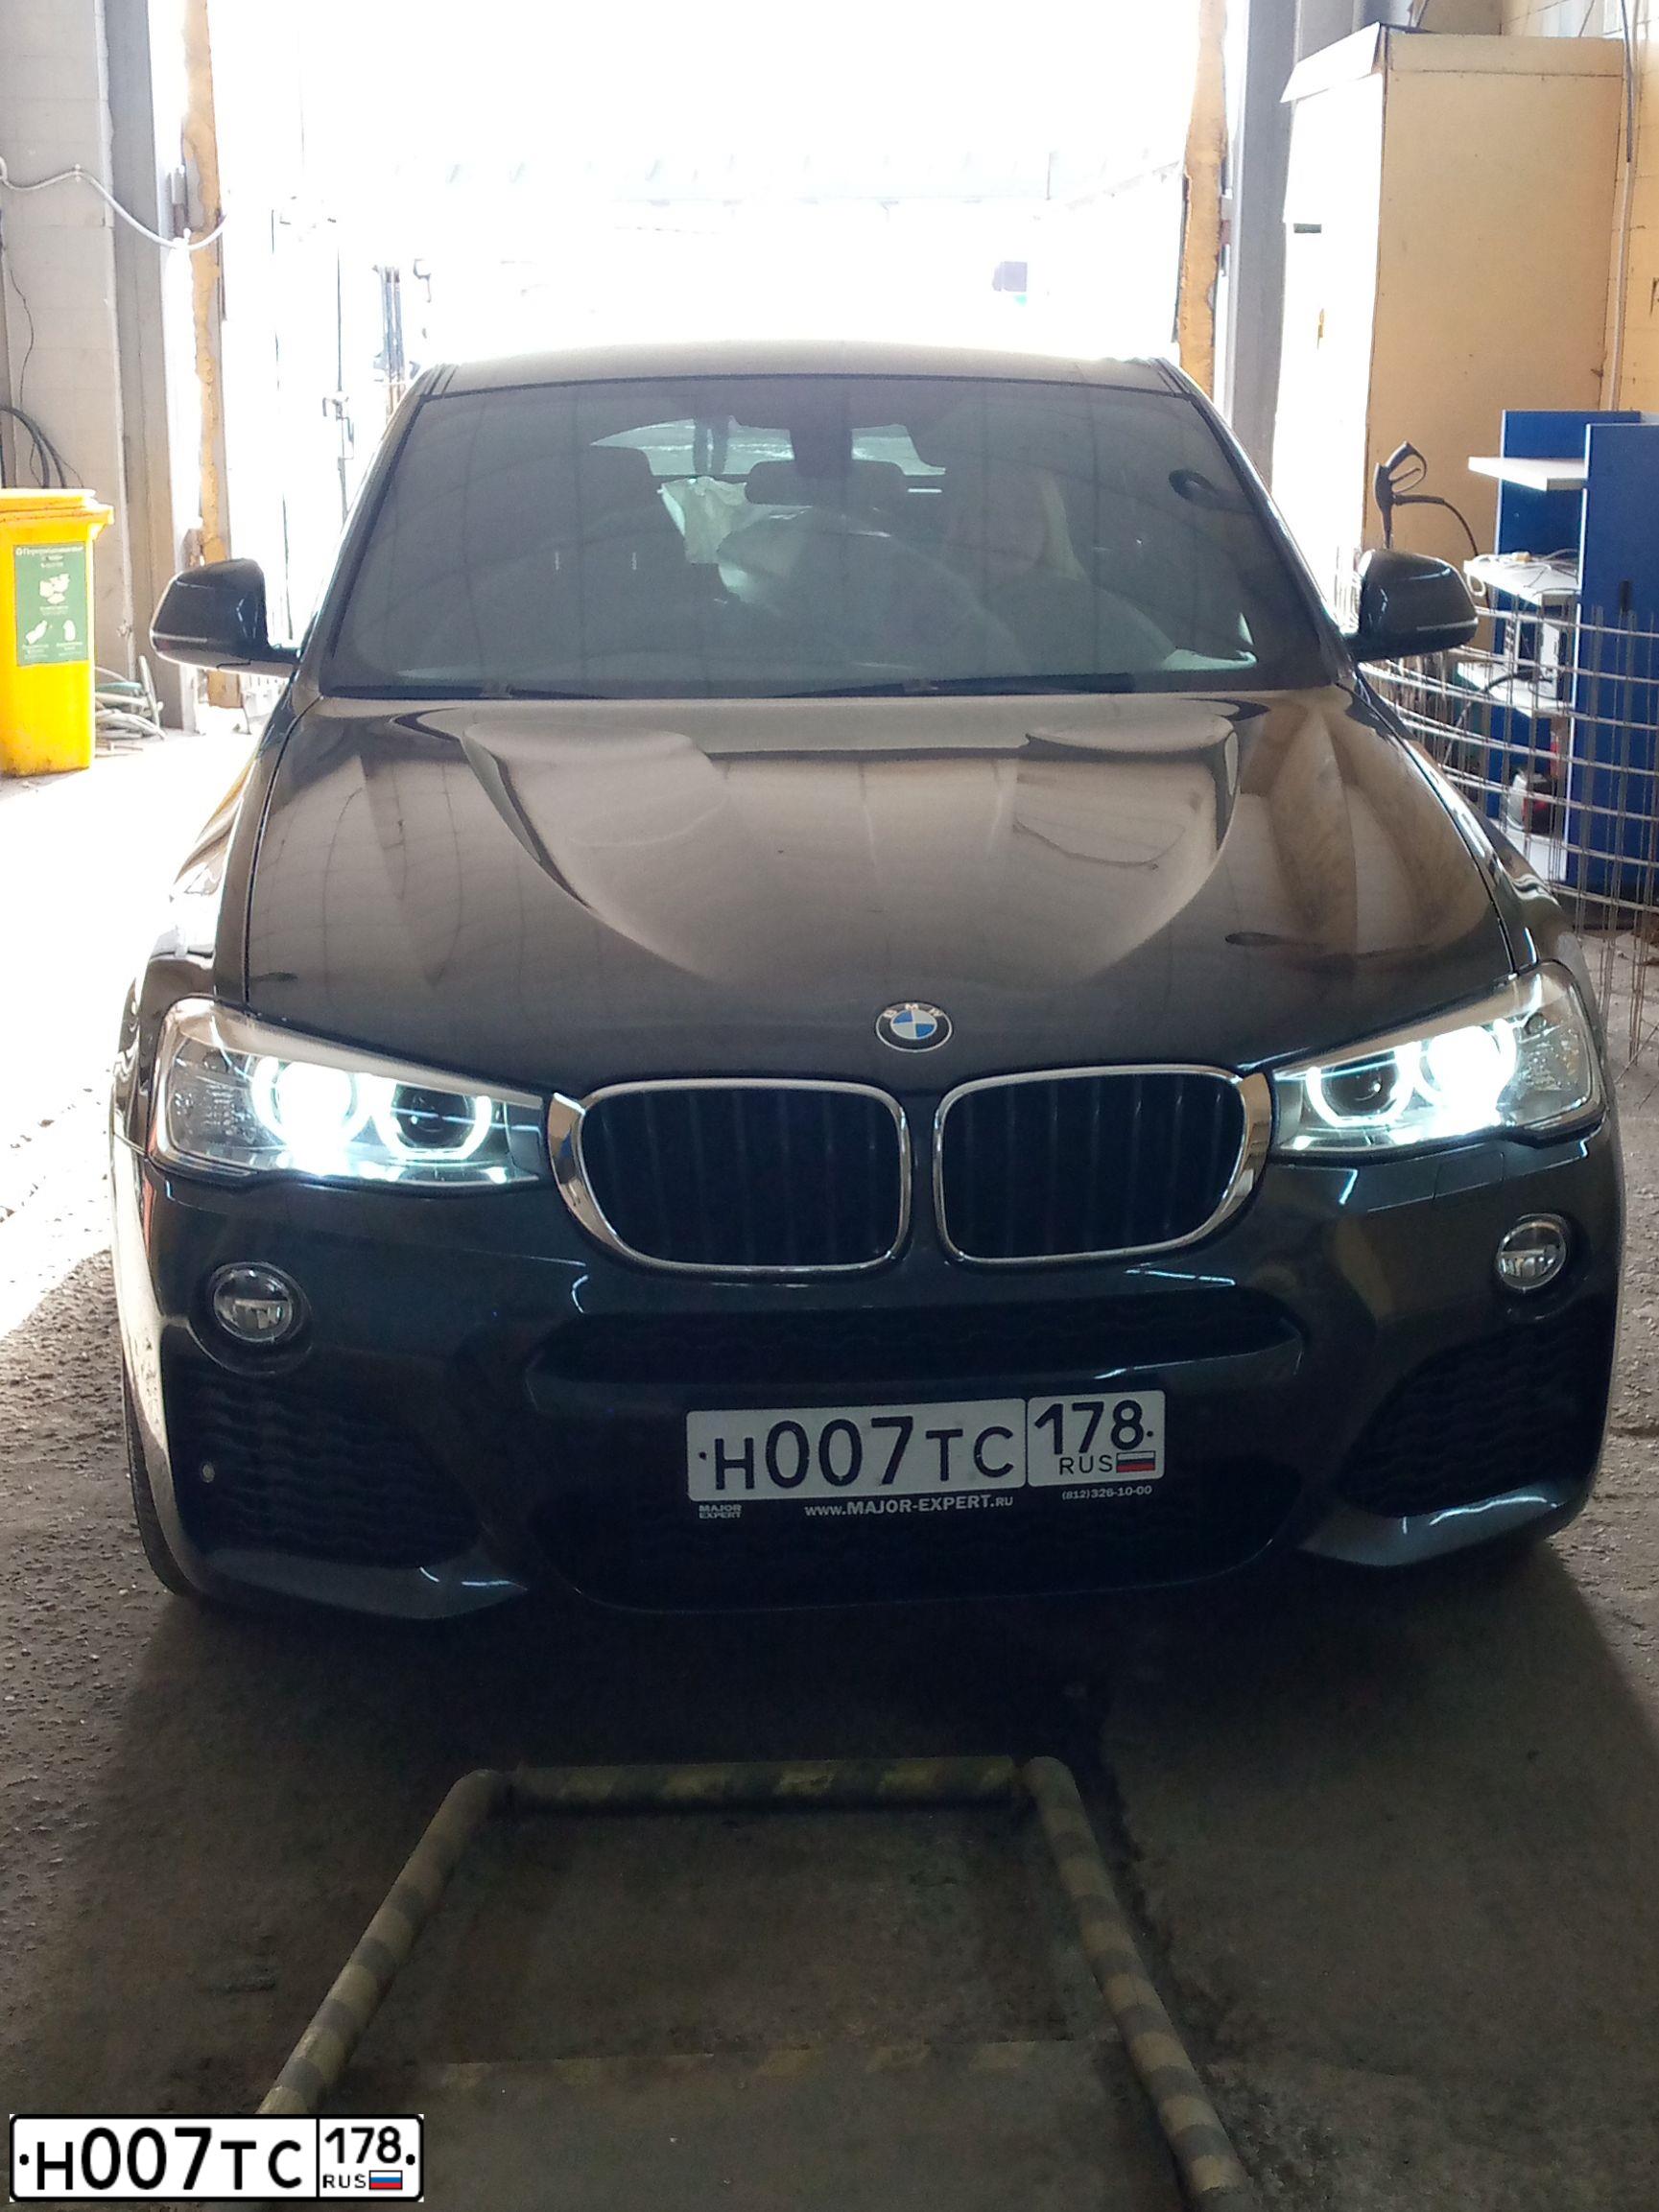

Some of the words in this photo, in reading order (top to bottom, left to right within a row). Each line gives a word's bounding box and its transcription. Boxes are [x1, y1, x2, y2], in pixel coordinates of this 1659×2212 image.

[714, 1415, 1014, 1491] H007TC
[1034, 1400, 1144, 1454] 178
[1059, 1454, 1113, 1475] RUS
